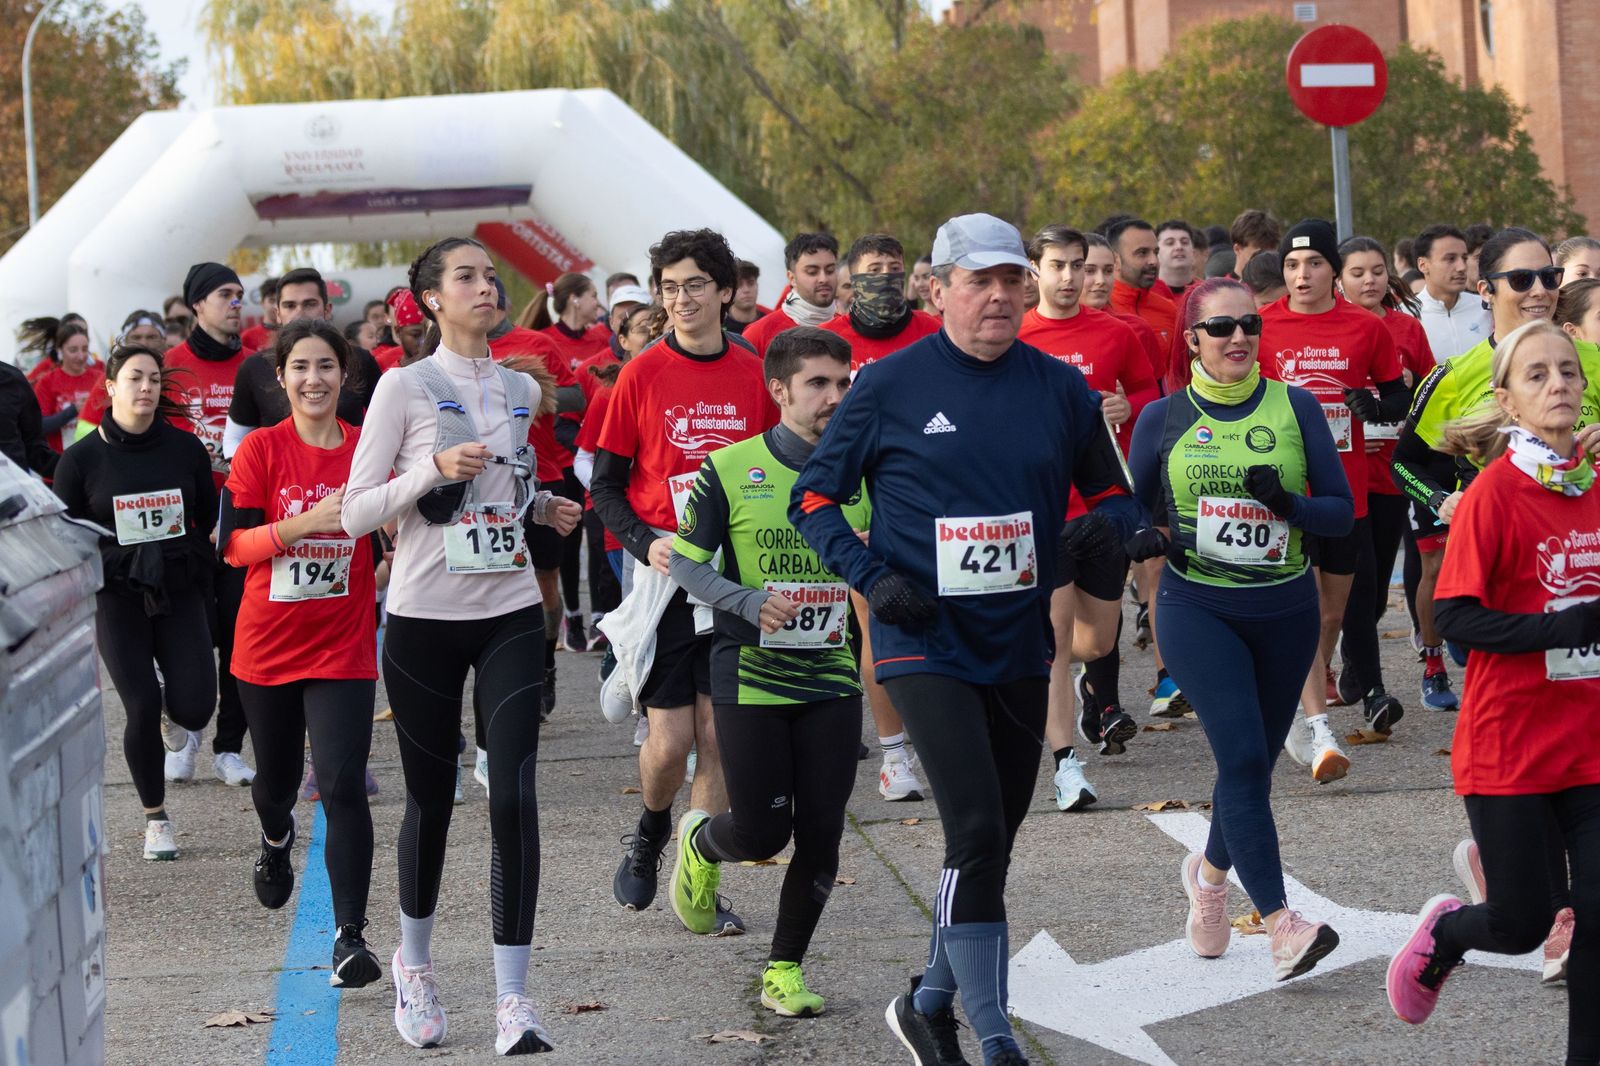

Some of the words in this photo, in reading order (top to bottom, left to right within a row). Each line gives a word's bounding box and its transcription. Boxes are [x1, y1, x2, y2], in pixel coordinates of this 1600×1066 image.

[506, 218, 573, 272] ORTISTAS
[1071, 352, 1083, 363] sin
[1328, 346, 1340, 358] sin
[1299, 358, 1349, 370] resistencias!
[696, 401, 721, 416] ¡Corre
[724, 402, 736, 416] sin
[692, 415, 747, 432] resistencias!
[923, 425, 957, 435] adidas
[116, 494, 181, 511] bedunia
[138, 510, 163, 530] 15
[940, 519, 1030, 541] bedunia
[1216, 522, 1270, 547] 430
[466, 526, 515, 554] 125
[960, 543, 1017, 573] 421
[289, 561, 336, 585] 194
[767, 586, 847, 603] edunia
